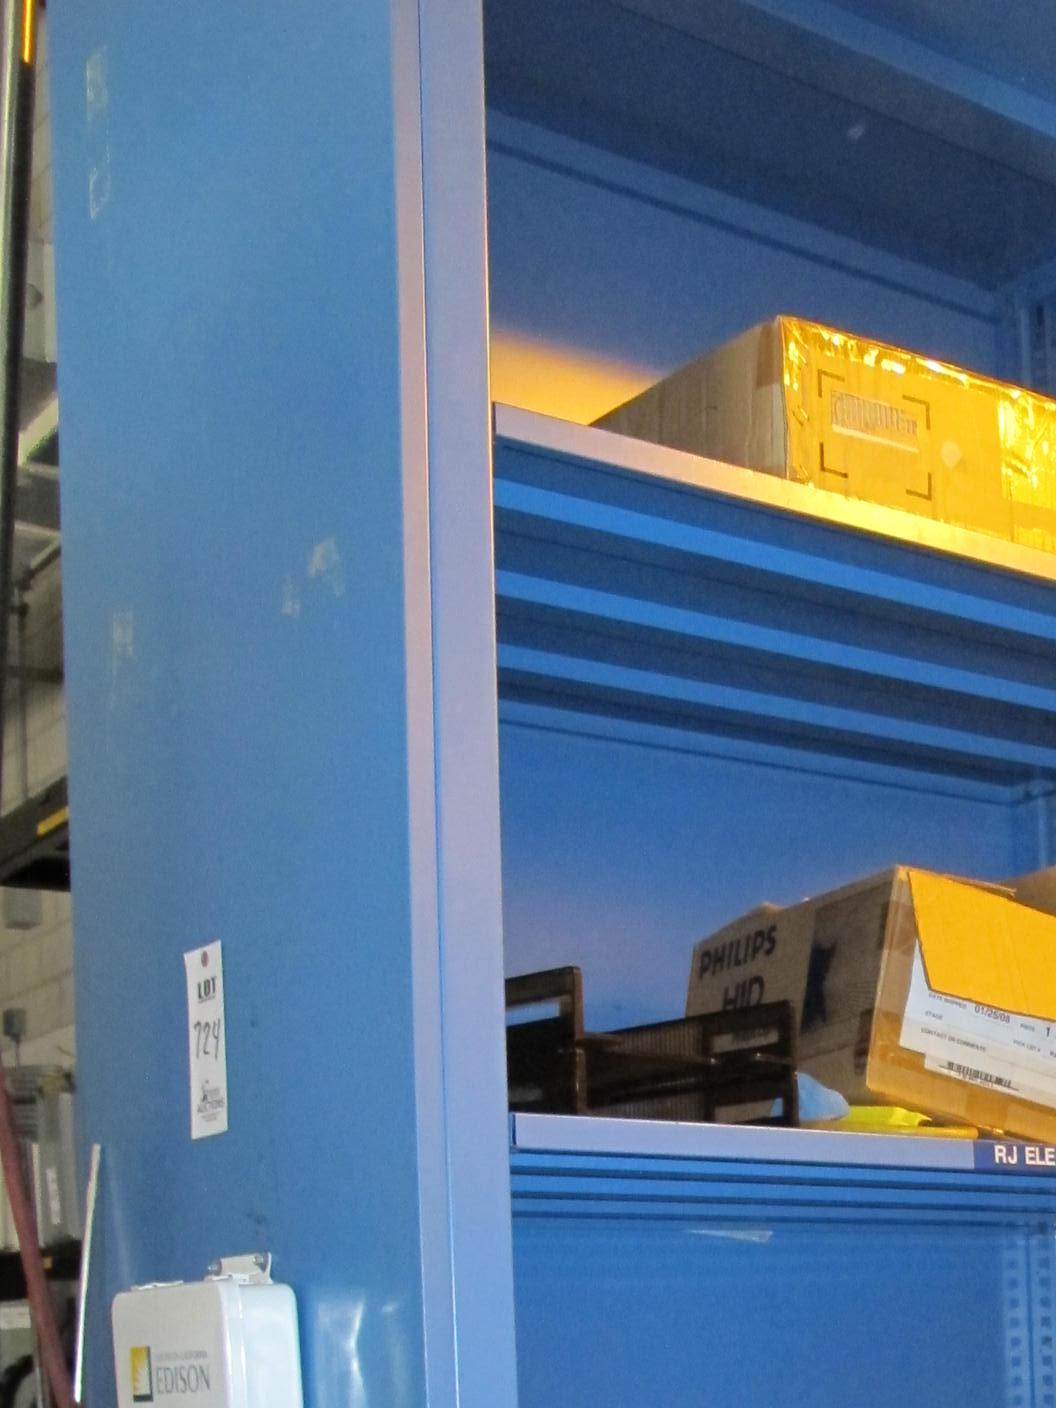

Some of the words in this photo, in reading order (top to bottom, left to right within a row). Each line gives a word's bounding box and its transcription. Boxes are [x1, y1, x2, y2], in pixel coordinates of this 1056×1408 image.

[699, 923, 777, 979] PHILIPS
[198, 976, 217, 999] LOT
[994, 1144, 1018, 1165] RJ
[156, 1364, 211, 1395] EDISON
